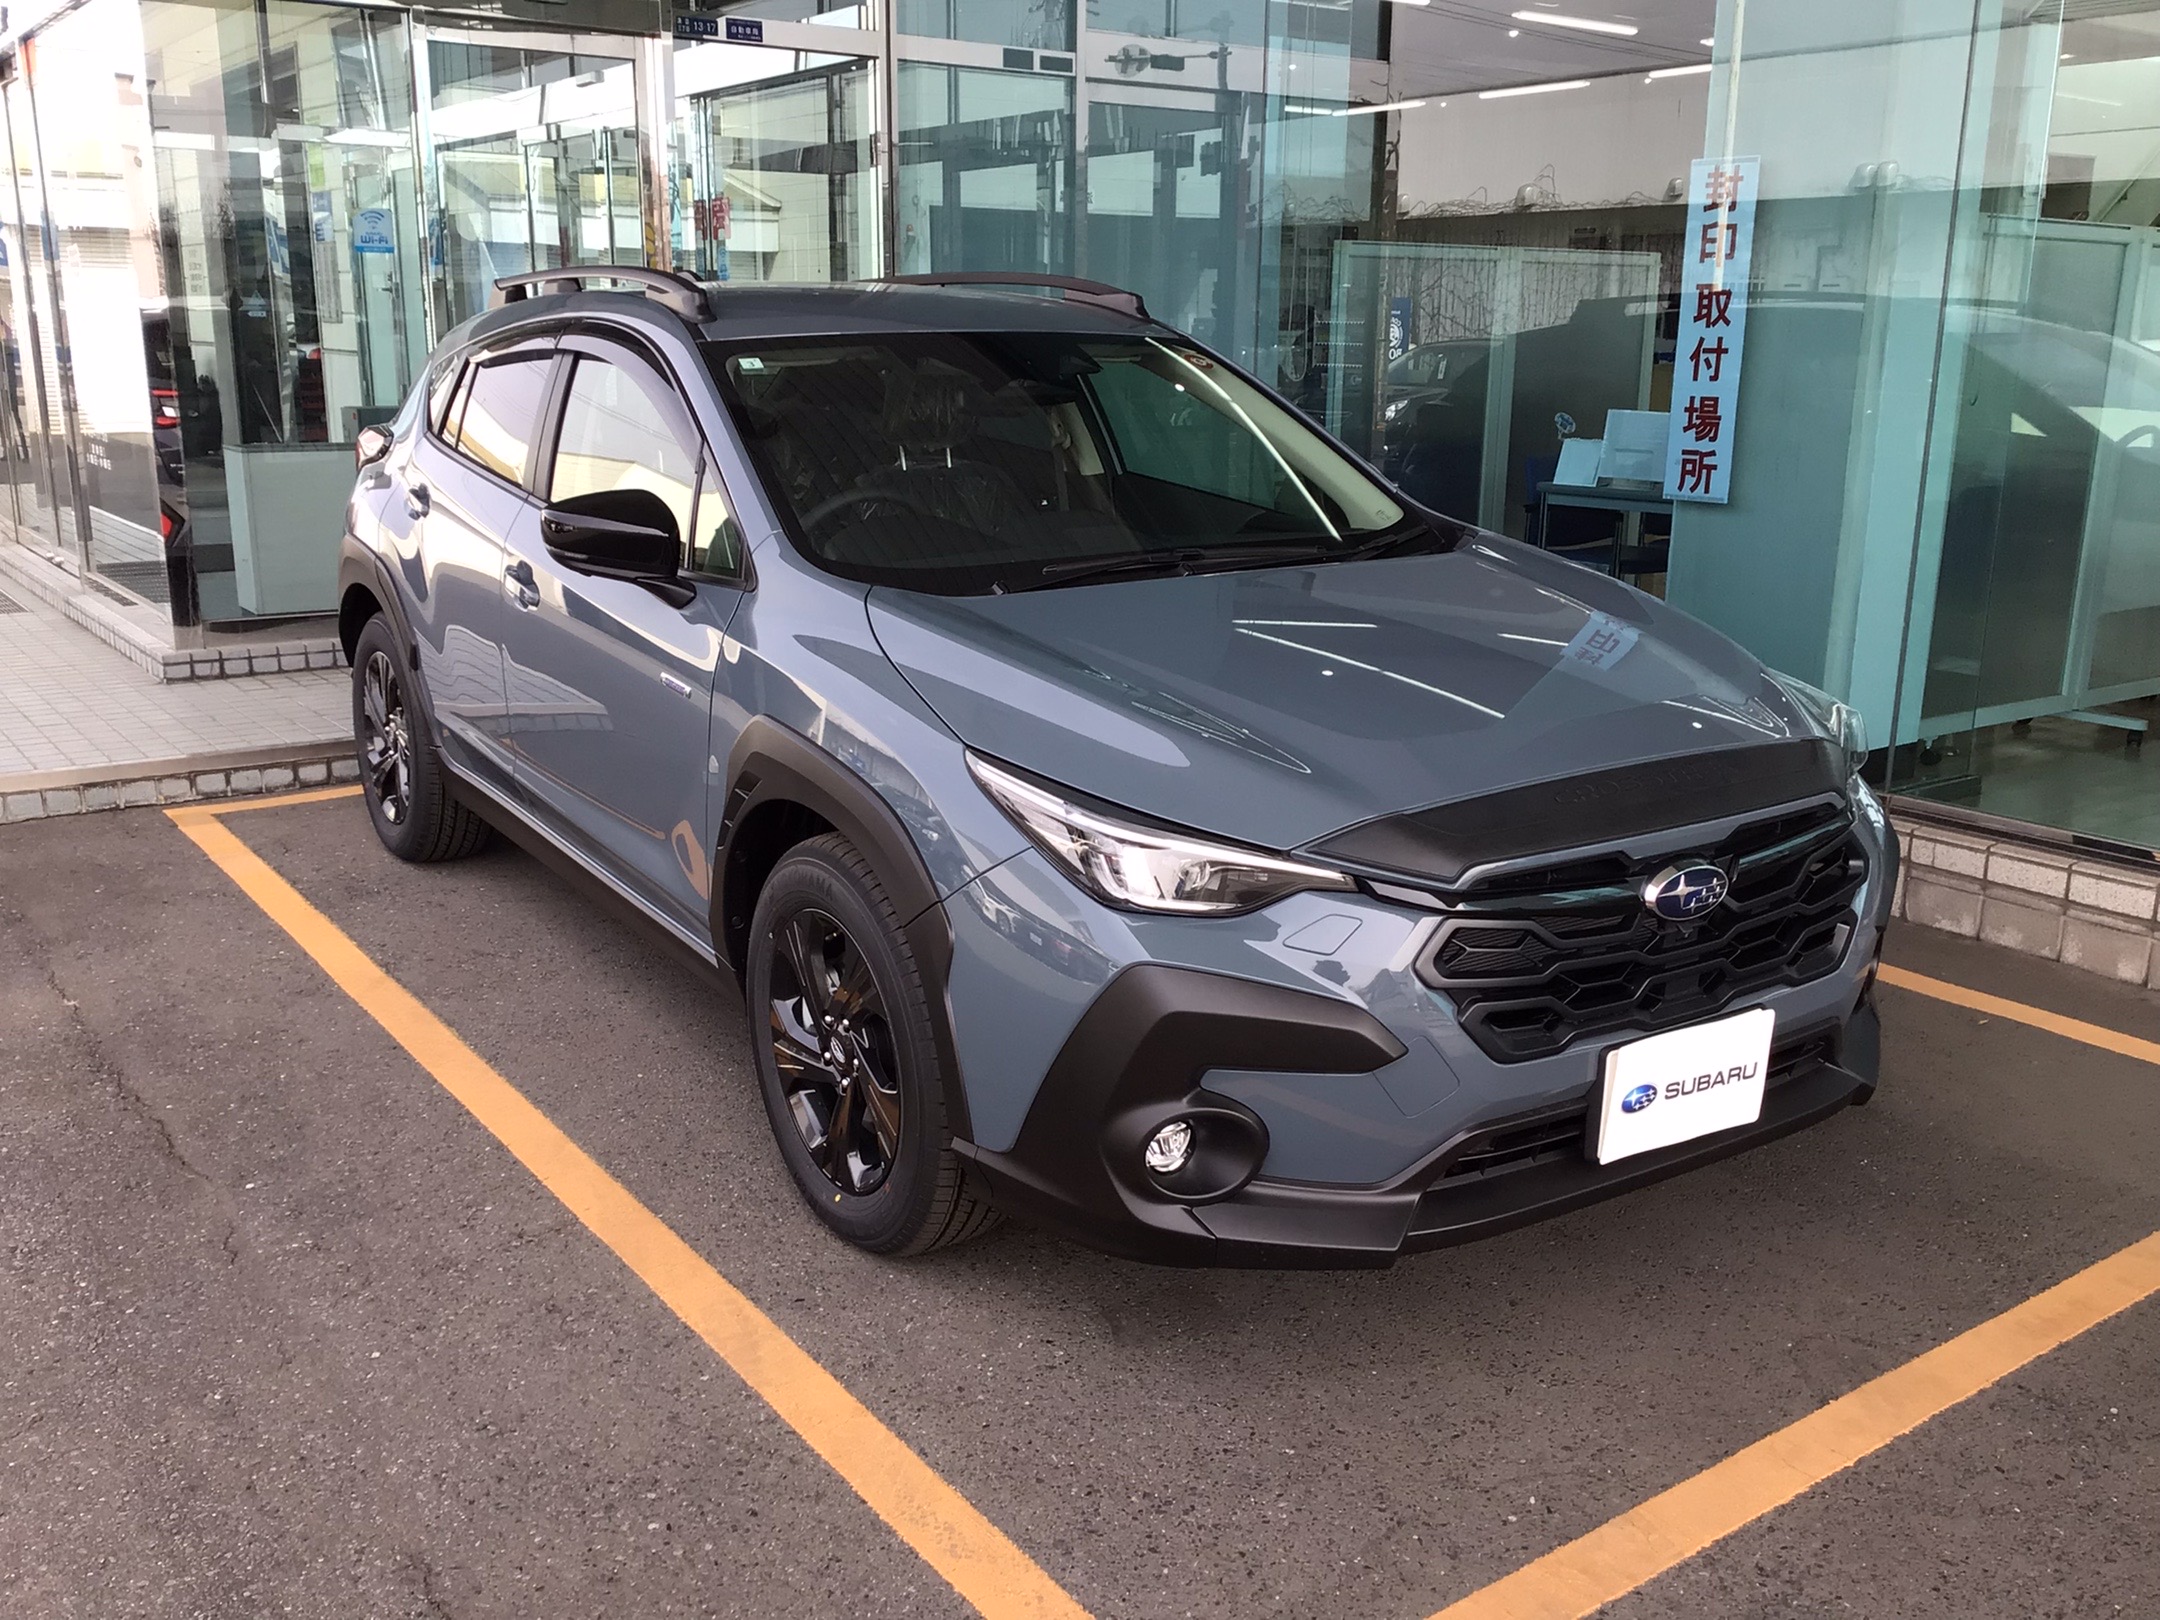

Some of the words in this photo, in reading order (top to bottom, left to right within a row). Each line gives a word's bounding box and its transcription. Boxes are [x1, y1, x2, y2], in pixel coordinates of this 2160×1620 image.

[360, 235, 389, 245] Wi-Fi
[1676, 163, 1744, 495] 封印取付場所
[1664, 1061, 1758, 1100] SUBARU
